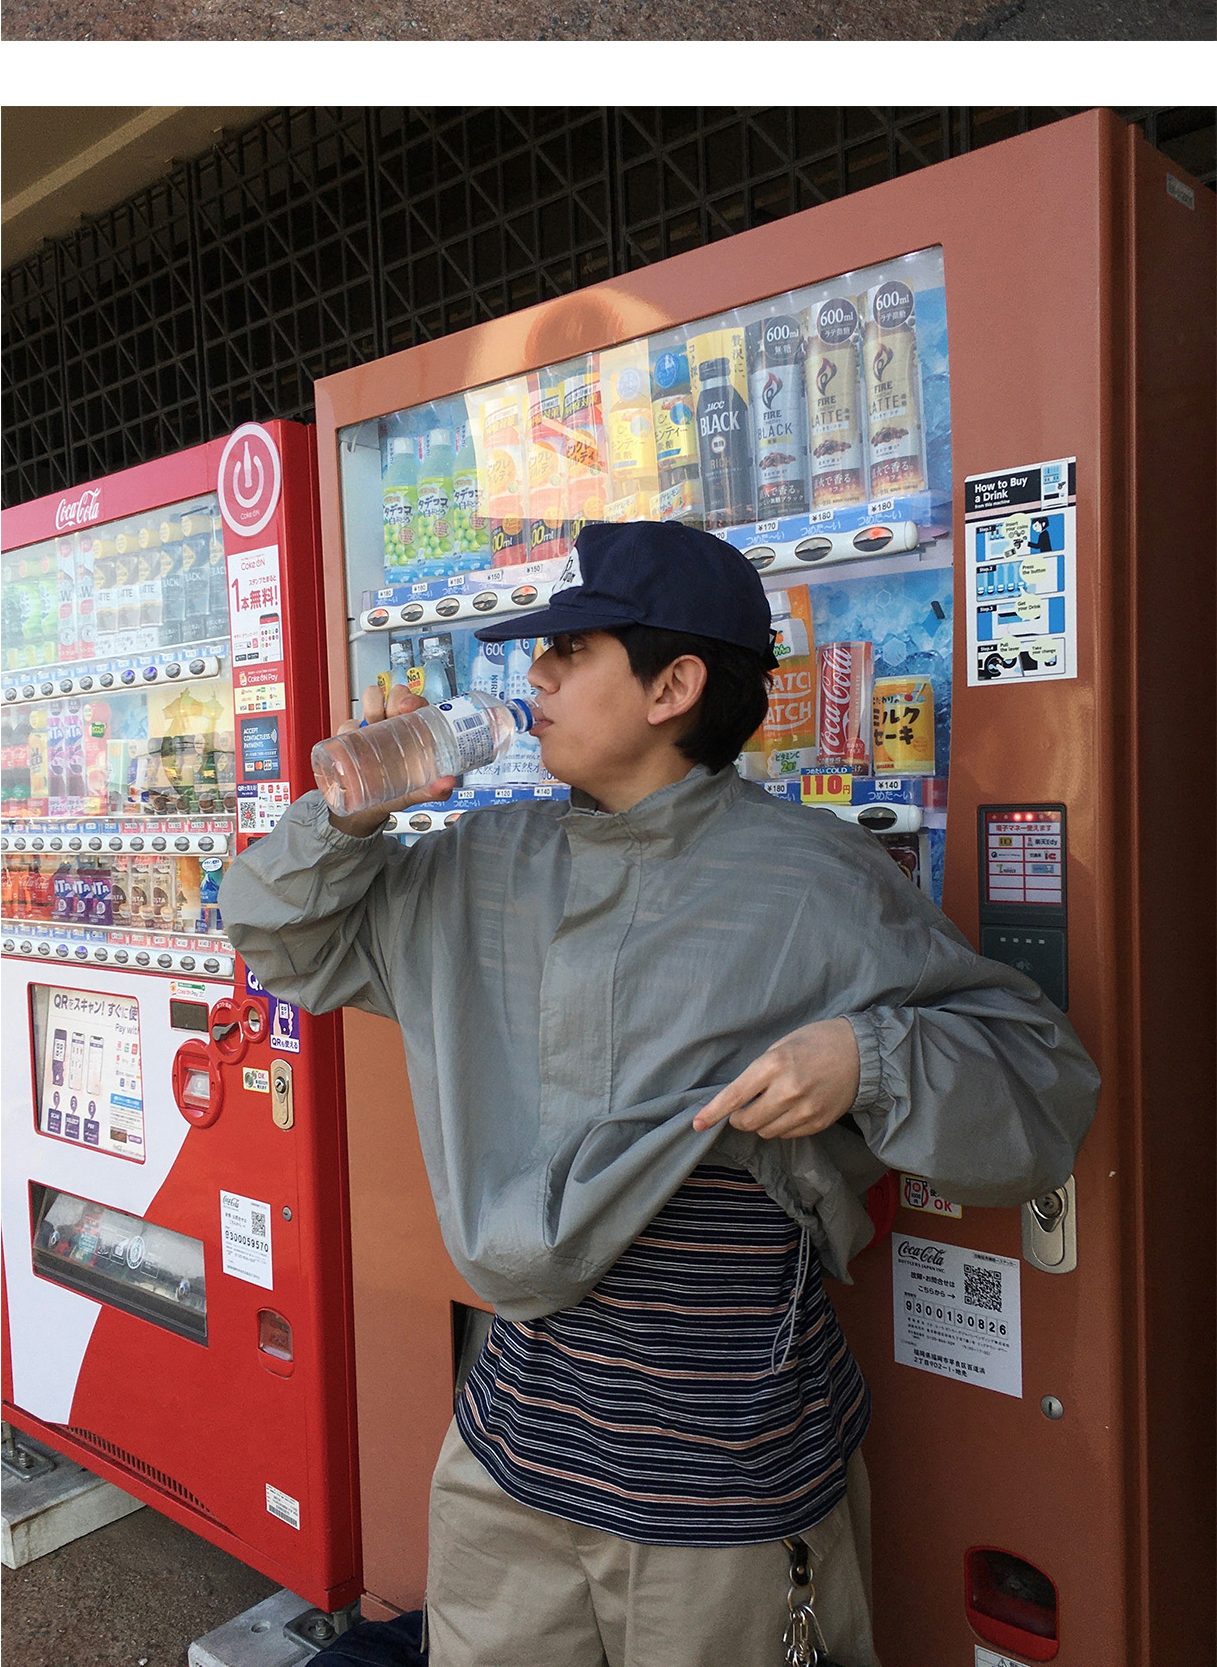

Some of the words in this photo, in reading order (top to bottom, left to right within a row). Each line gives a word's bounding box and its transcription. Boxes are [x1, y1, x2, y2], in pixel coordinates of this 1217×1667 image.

[876, 291, 910, 310] 600ml
[820, 308, 854, 325] 600ml
[767, 325, 798, 341] 600ml
[774, 346, 792, 355] 無糖
[874, 381, 893, 394] FIRE
[706, 401, 725, 412] UCC
[817, 395, 837, 406] FIRE
[869, 394, 899, 416] LATTE
[700, 411, 740, 436] BLACK
[763, 410, 782, 421] FIRE
[812, 408, 843, 428] LATTE
[758, 423, 793, 440] BLACK
[974, 482, 995, 493] How
[998, 481, 1007, 490] to
[1011, 476, 1028, 488] Buy
[983, 490, 1008, 501] Drink
[55, 487, 100, 531] Coca-Cola
[871, 501, 892, 512] ¥180
[812, 512, 831, 521] ¥180
[758, 523, 776, 531] ¥170
[241, 561, 256, 570] Coke
[527, 565, 541, 573] ¥150
[231, 578, 278, 613] 1本無料!
[247, 675, 259, 683] Coke
[268, 673, 278, 682] Pay
[407, 672, 421, 682] No.1
[822, 647, 852, 756] Coca-Cola
[874, 707, 920, 726] ミルク
[244, 734, 271, 742] CONTACTLESS
[874, 727, 914, 746] セーキ
[802, 775, 850, 795] 110円
[878, 781, 898, 789] ¥140
[54, 994, 105, 1015] QRをスキャン!
[934, 1199, 952, 1212] OK
[898, 1241, 946, 1266] Coca-Cola
[911, 1272, 955, 1288] 故障・お問合せは
[918, 1285, 945, 1297] こちらから
[906, 1300, 1006, 1335] 9300130826
